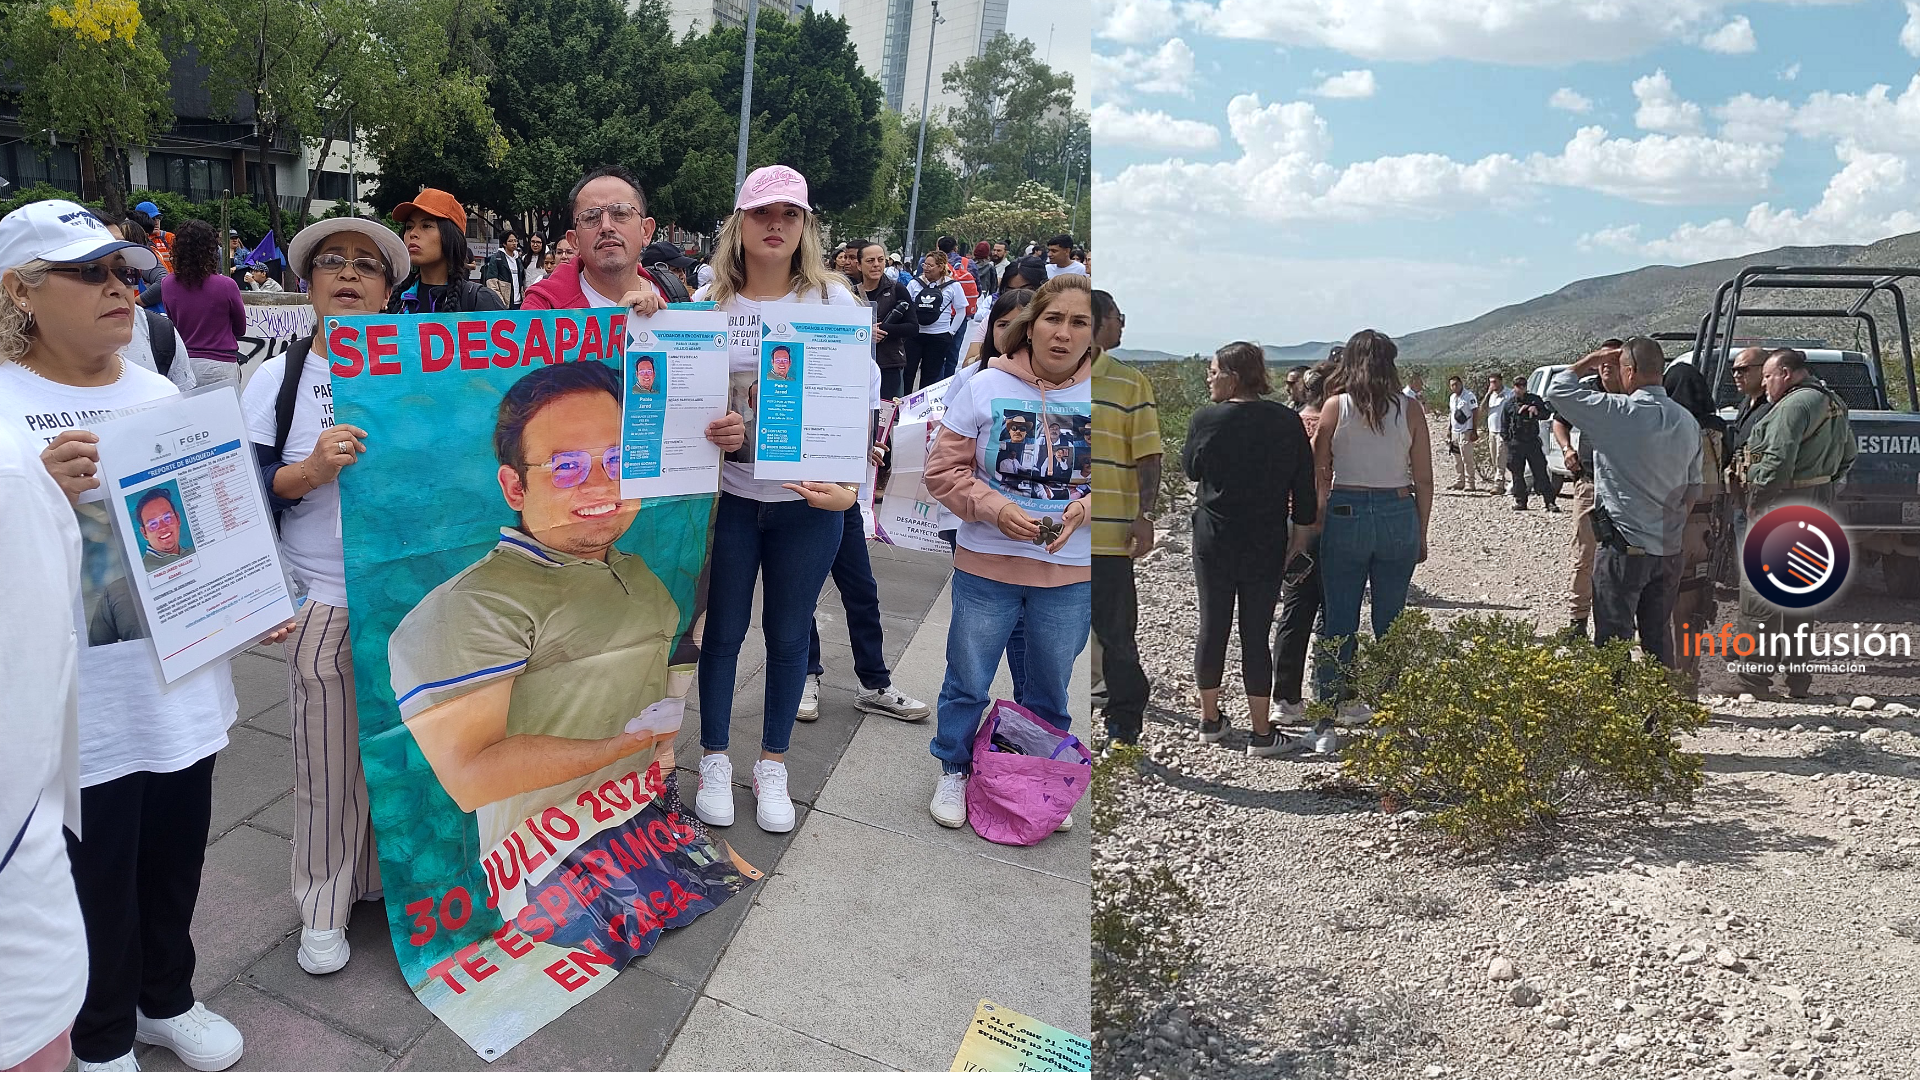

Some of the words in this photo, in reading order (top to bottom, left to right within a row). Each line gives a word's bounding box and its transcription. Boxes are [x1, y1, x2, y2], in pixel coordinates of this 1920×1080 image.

[328, 325, 402, 378] SE
[418, 314, 626, 373] DESAPAR
[313, 382, 332, 399] PAB
[1022, 400, 1034, 411] Te
[25, 411, 75, 431] PABLO
[320, 418, 335, 429] HA
[180, 430, 210, 445] FGED
[1857, 435, 1920, 454] ESTATA
[176, 461, 186, 469] DE
[896, 516, 938, 529] DESAPARECID
[405, 886, 473, 947] 30
[482, 806, 580, 910] JULIO
[576, 761, 668, 824] 2024
[426, 942, 500, 995] TE
[493, 812, 696, 960] ESPERAMOS
[543, 938, 616, 993] EN
[608, 879, 705, 951] CASA
[978, 1029, 1018, 1050] cuántas
[987, 1022, 1027, 1044] silencio,
[1020, 1048, 1033, 1057] de
[1066, 1046, 1081, 1057] un
